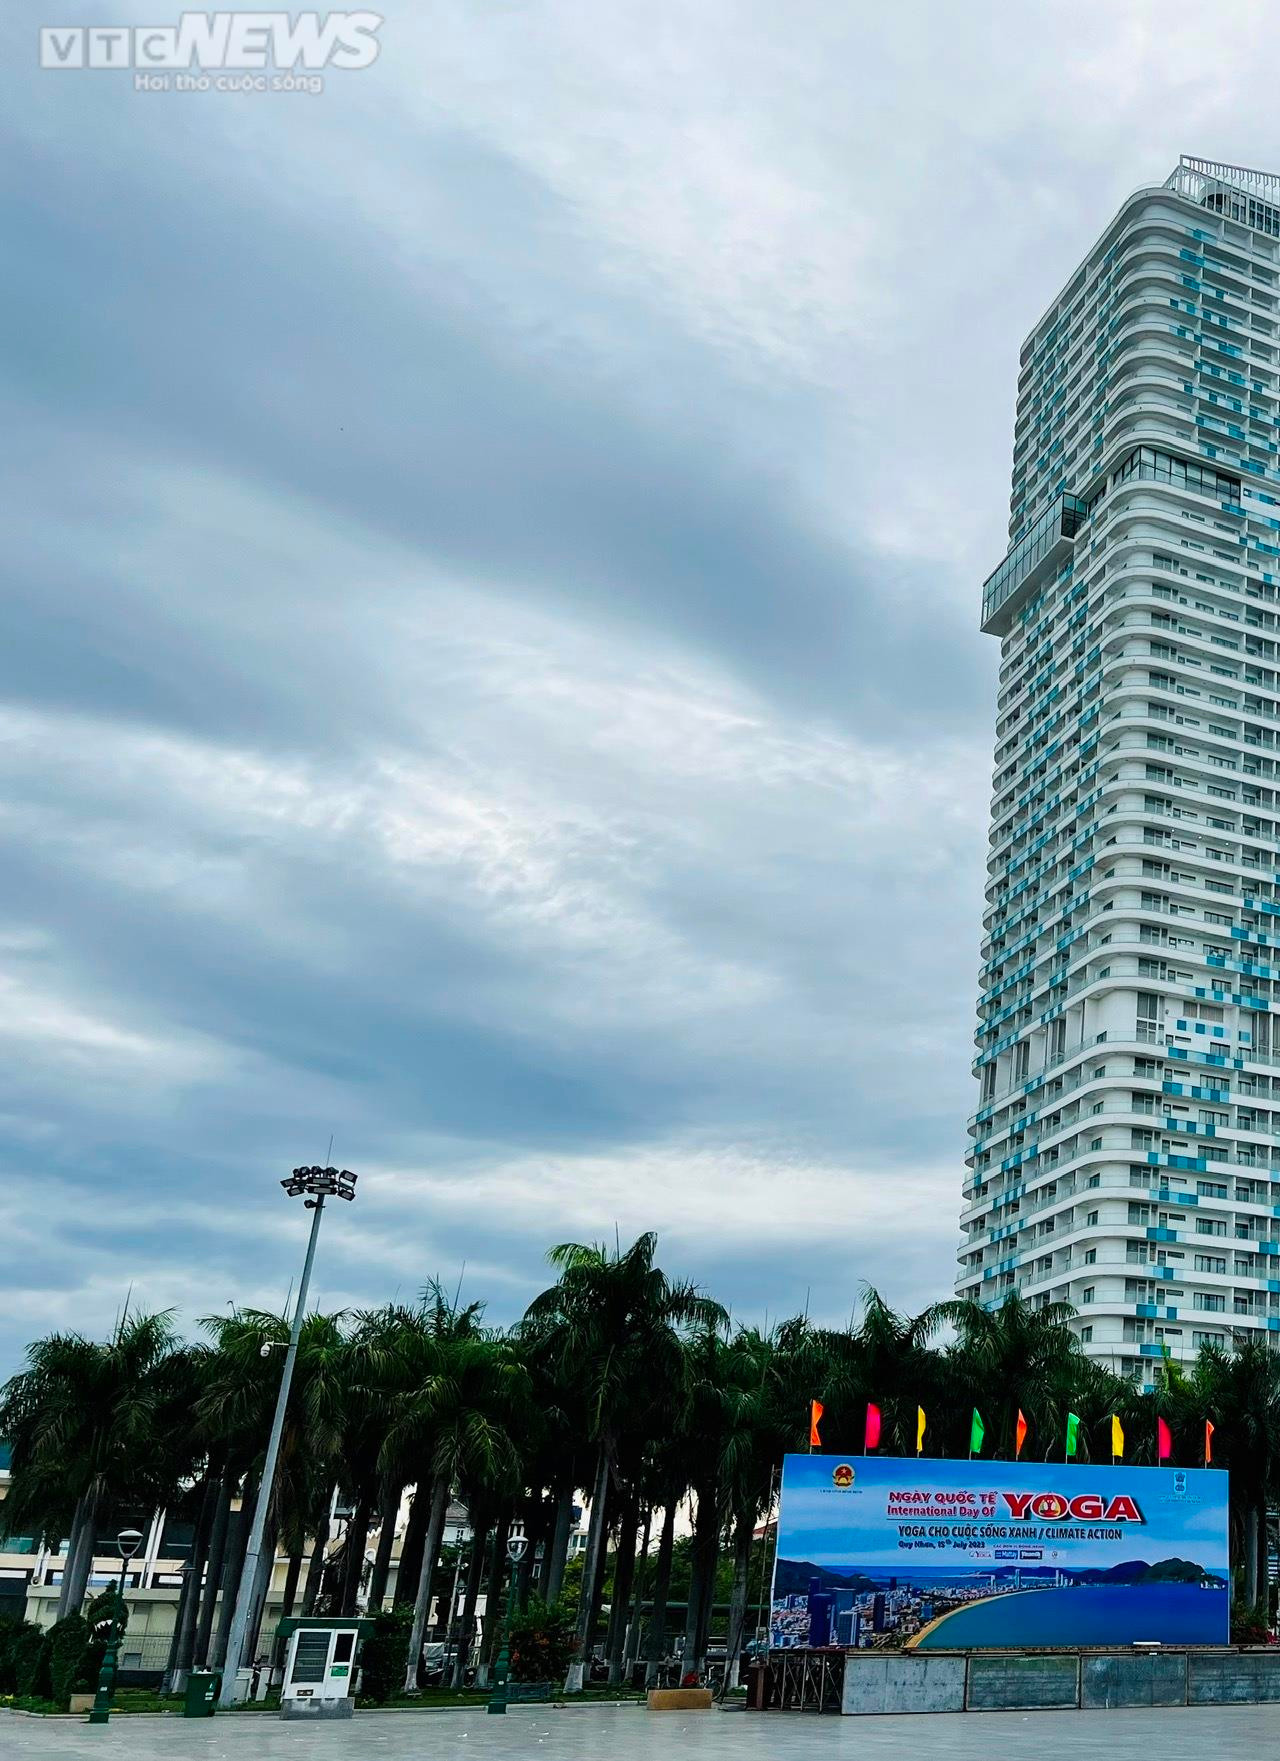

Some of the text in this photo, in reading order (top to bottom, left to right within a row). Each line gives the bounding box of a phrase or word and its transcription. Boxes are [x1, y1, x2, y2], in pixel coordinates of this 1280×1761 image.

[889, 1490, 998, 1505] NGÀY QUỐC TẾ
[887, 1505, 996, 1519] International Day Of
[1002, 1491, 1143, 1521] YOGA
[898, 1525, 925, 1537] YOGA
[928, 1525, 950, 1538] CHO
[952, 1523, 979, 1540] CUỘC
[979, 1523, 1007, 1538] SỐNG
[1008, 1527, 1038, 1539] XANH
[1045, 1527, 1085, 1539] CLIMATE
[1086, 1528, 1123, 1540] ACTION
[898, 1540, 913, 1550] Quy
[953, 1540, 968, 1550] July
[968, 1541, 985, 1549] 2023
